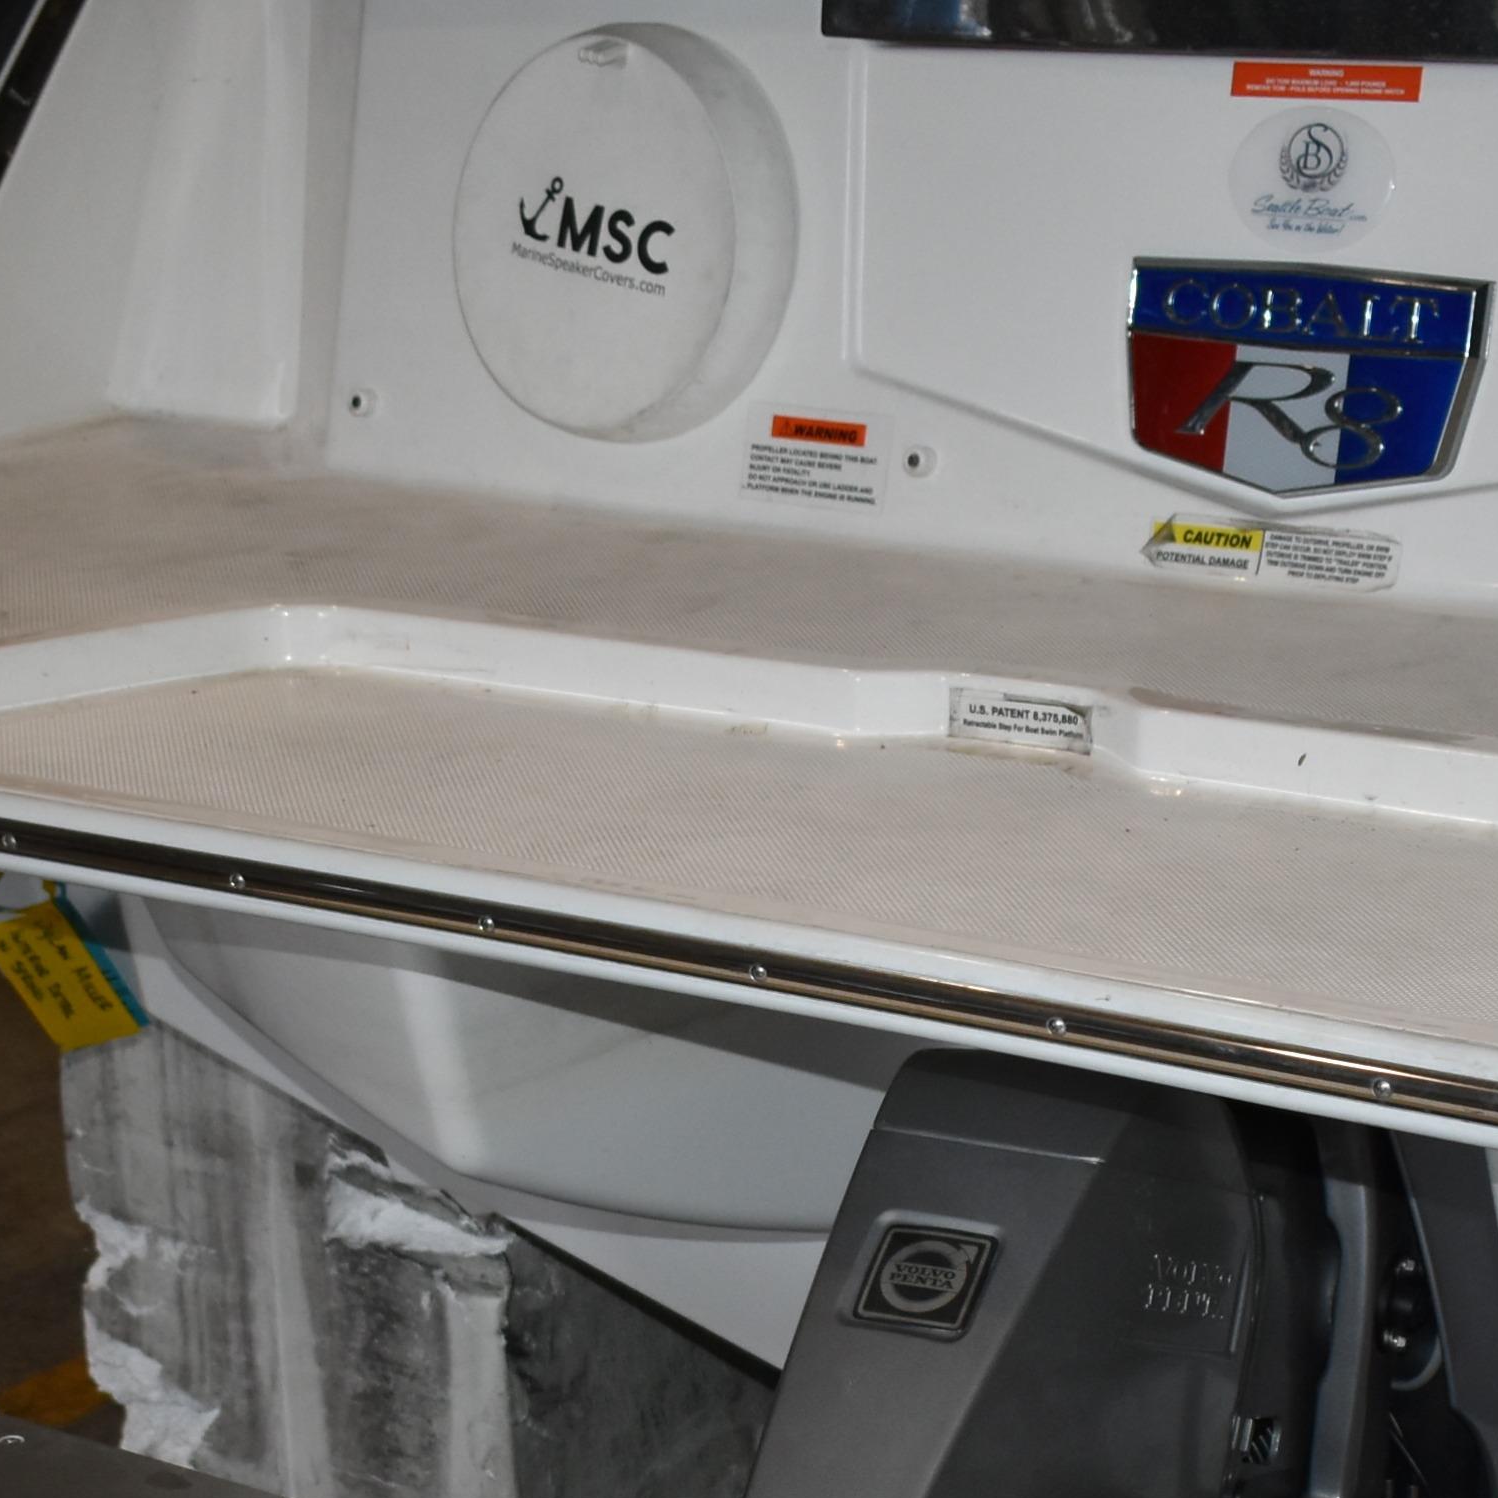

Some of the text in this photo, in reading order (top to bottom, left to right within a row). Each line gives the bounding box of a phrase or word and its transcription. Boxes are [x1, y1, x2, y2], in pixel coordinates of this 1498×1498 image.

[557, 196, 675, 275] MSC
[512, 242, 666, 297] MarineSpeakerCovers.com
[1163, 278, 1439, 344] COBALT
[1174, 361, 1403, 470] R8
[793, 424, 857, 443] WARNING
[1183, 529, 1253, 549] CAUTION
[1156, 551, 1249, 570] POTENTIAL DAMAGE
[969, 704, 989, 715] U.S.
[991, 706, 1030, 719] PATENT
[889, 1272, 954, 1289] PENTA
[895, 1263, 956, 1280] VOLVO
